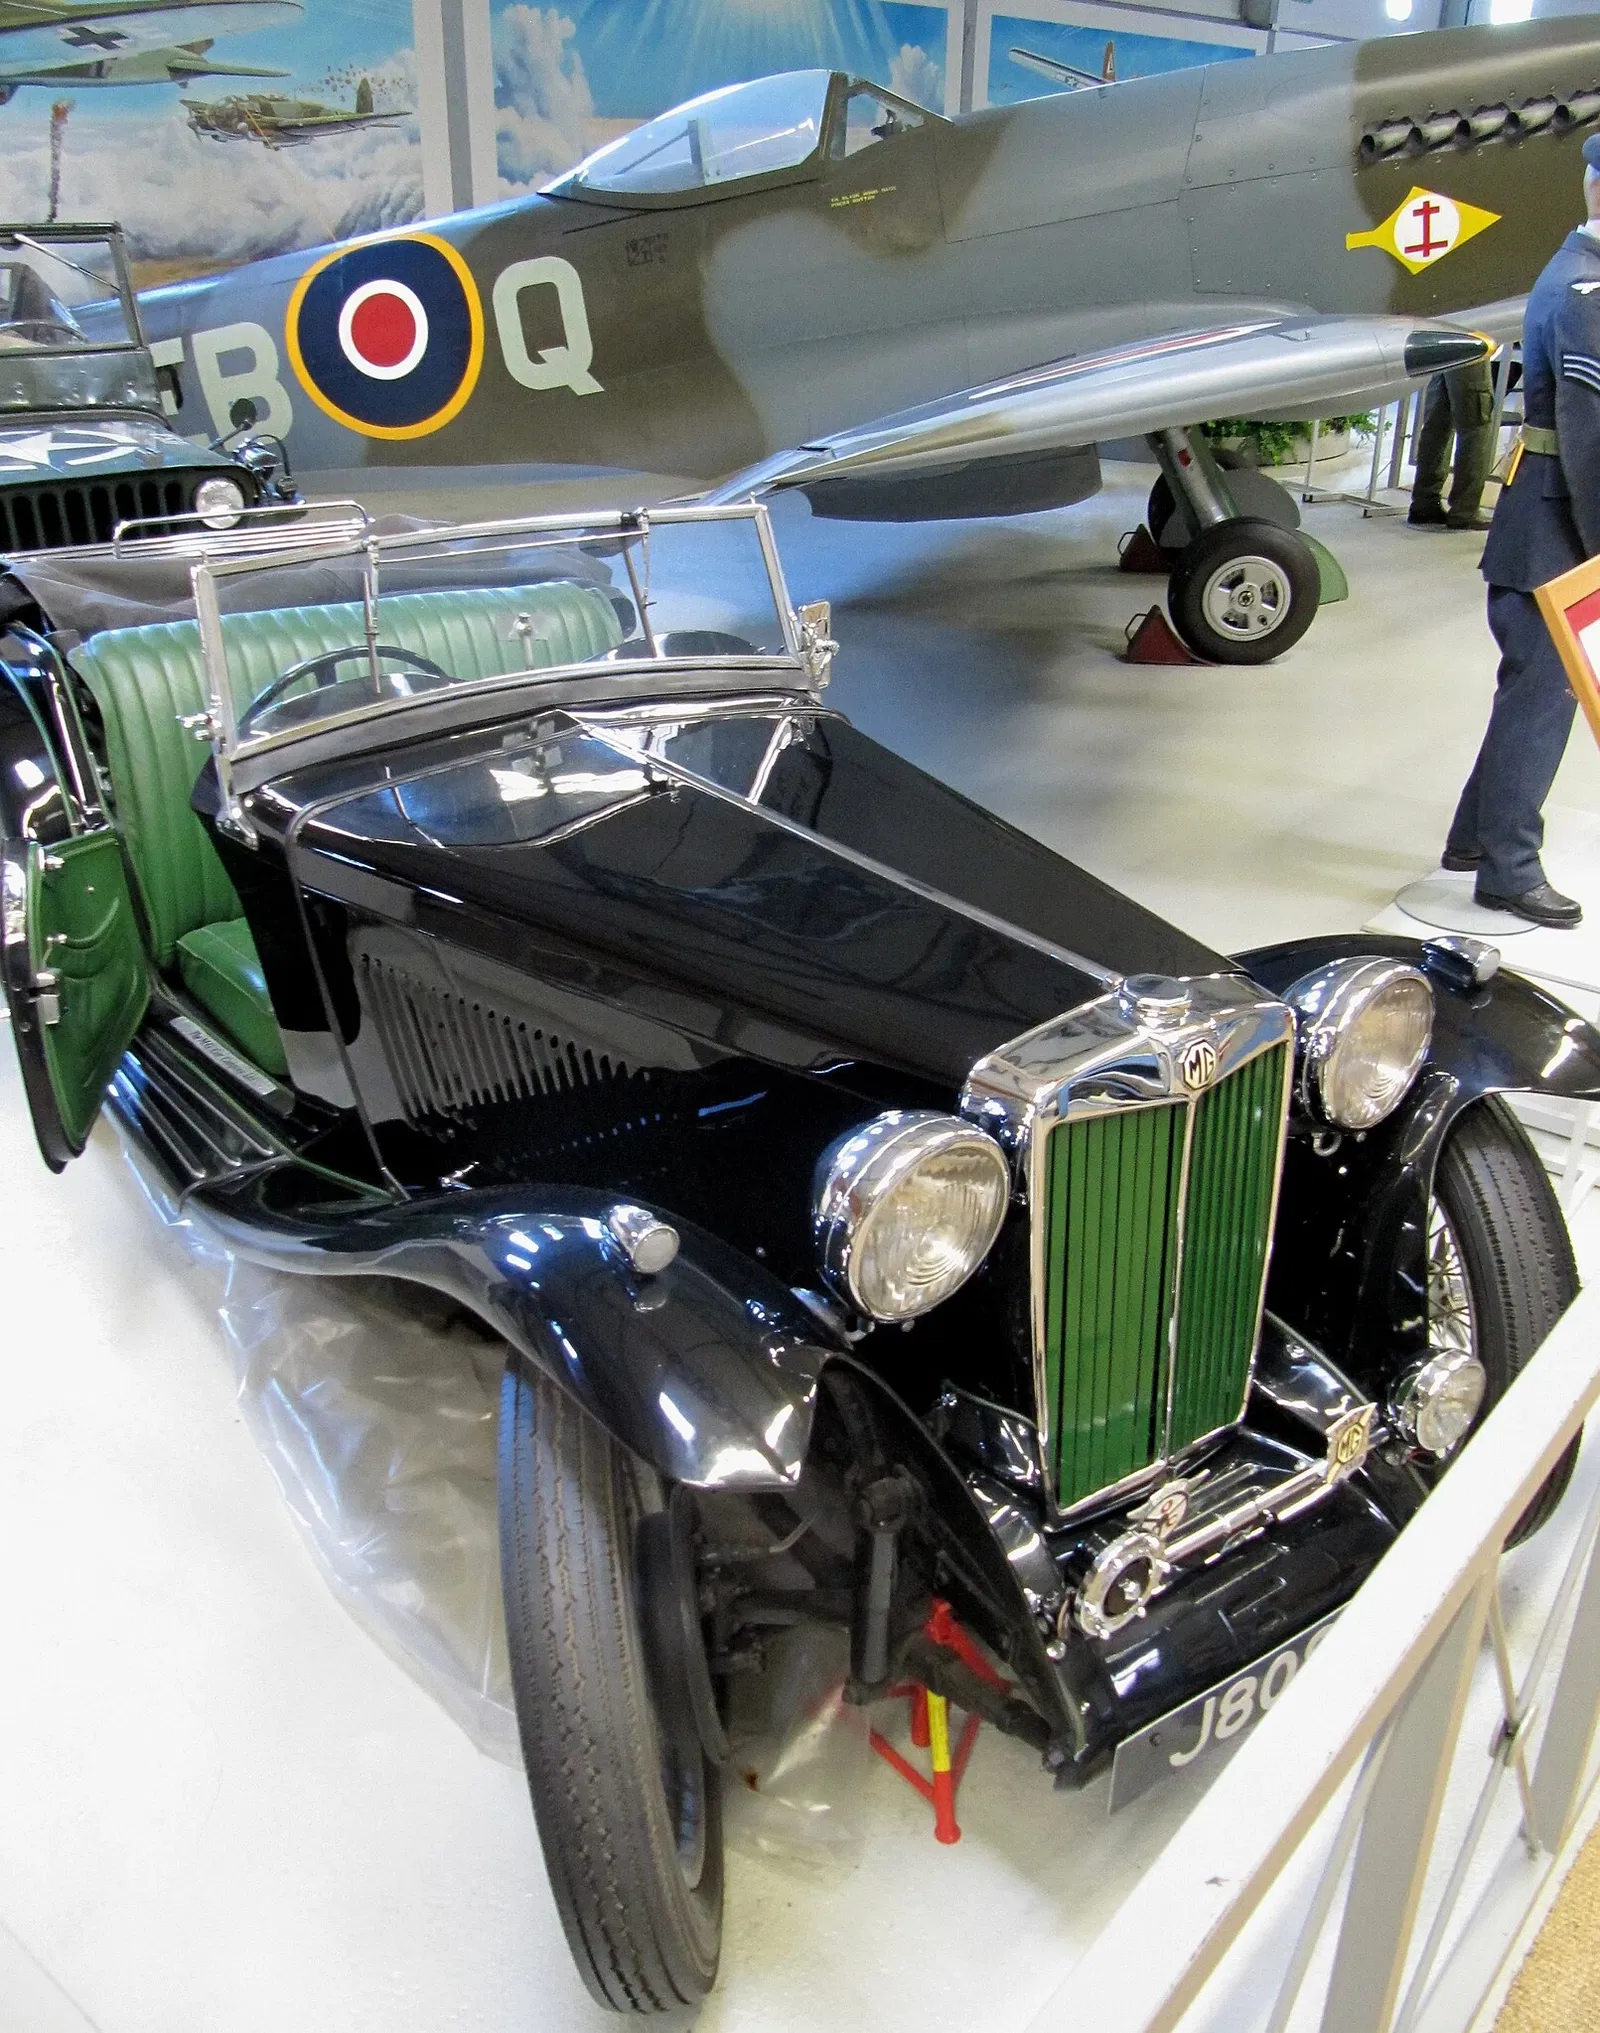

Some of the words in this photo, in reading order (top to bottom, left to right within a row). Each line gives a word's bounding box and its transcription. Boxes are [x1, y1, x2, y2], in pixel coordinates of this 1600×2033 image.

[492, 256, 605, 396] Q
[1187, 1045, 1215, 1086] MG
[1339, 1425, 1362, 1459] MG
[1169, 1622, 1338, 1767] J80
